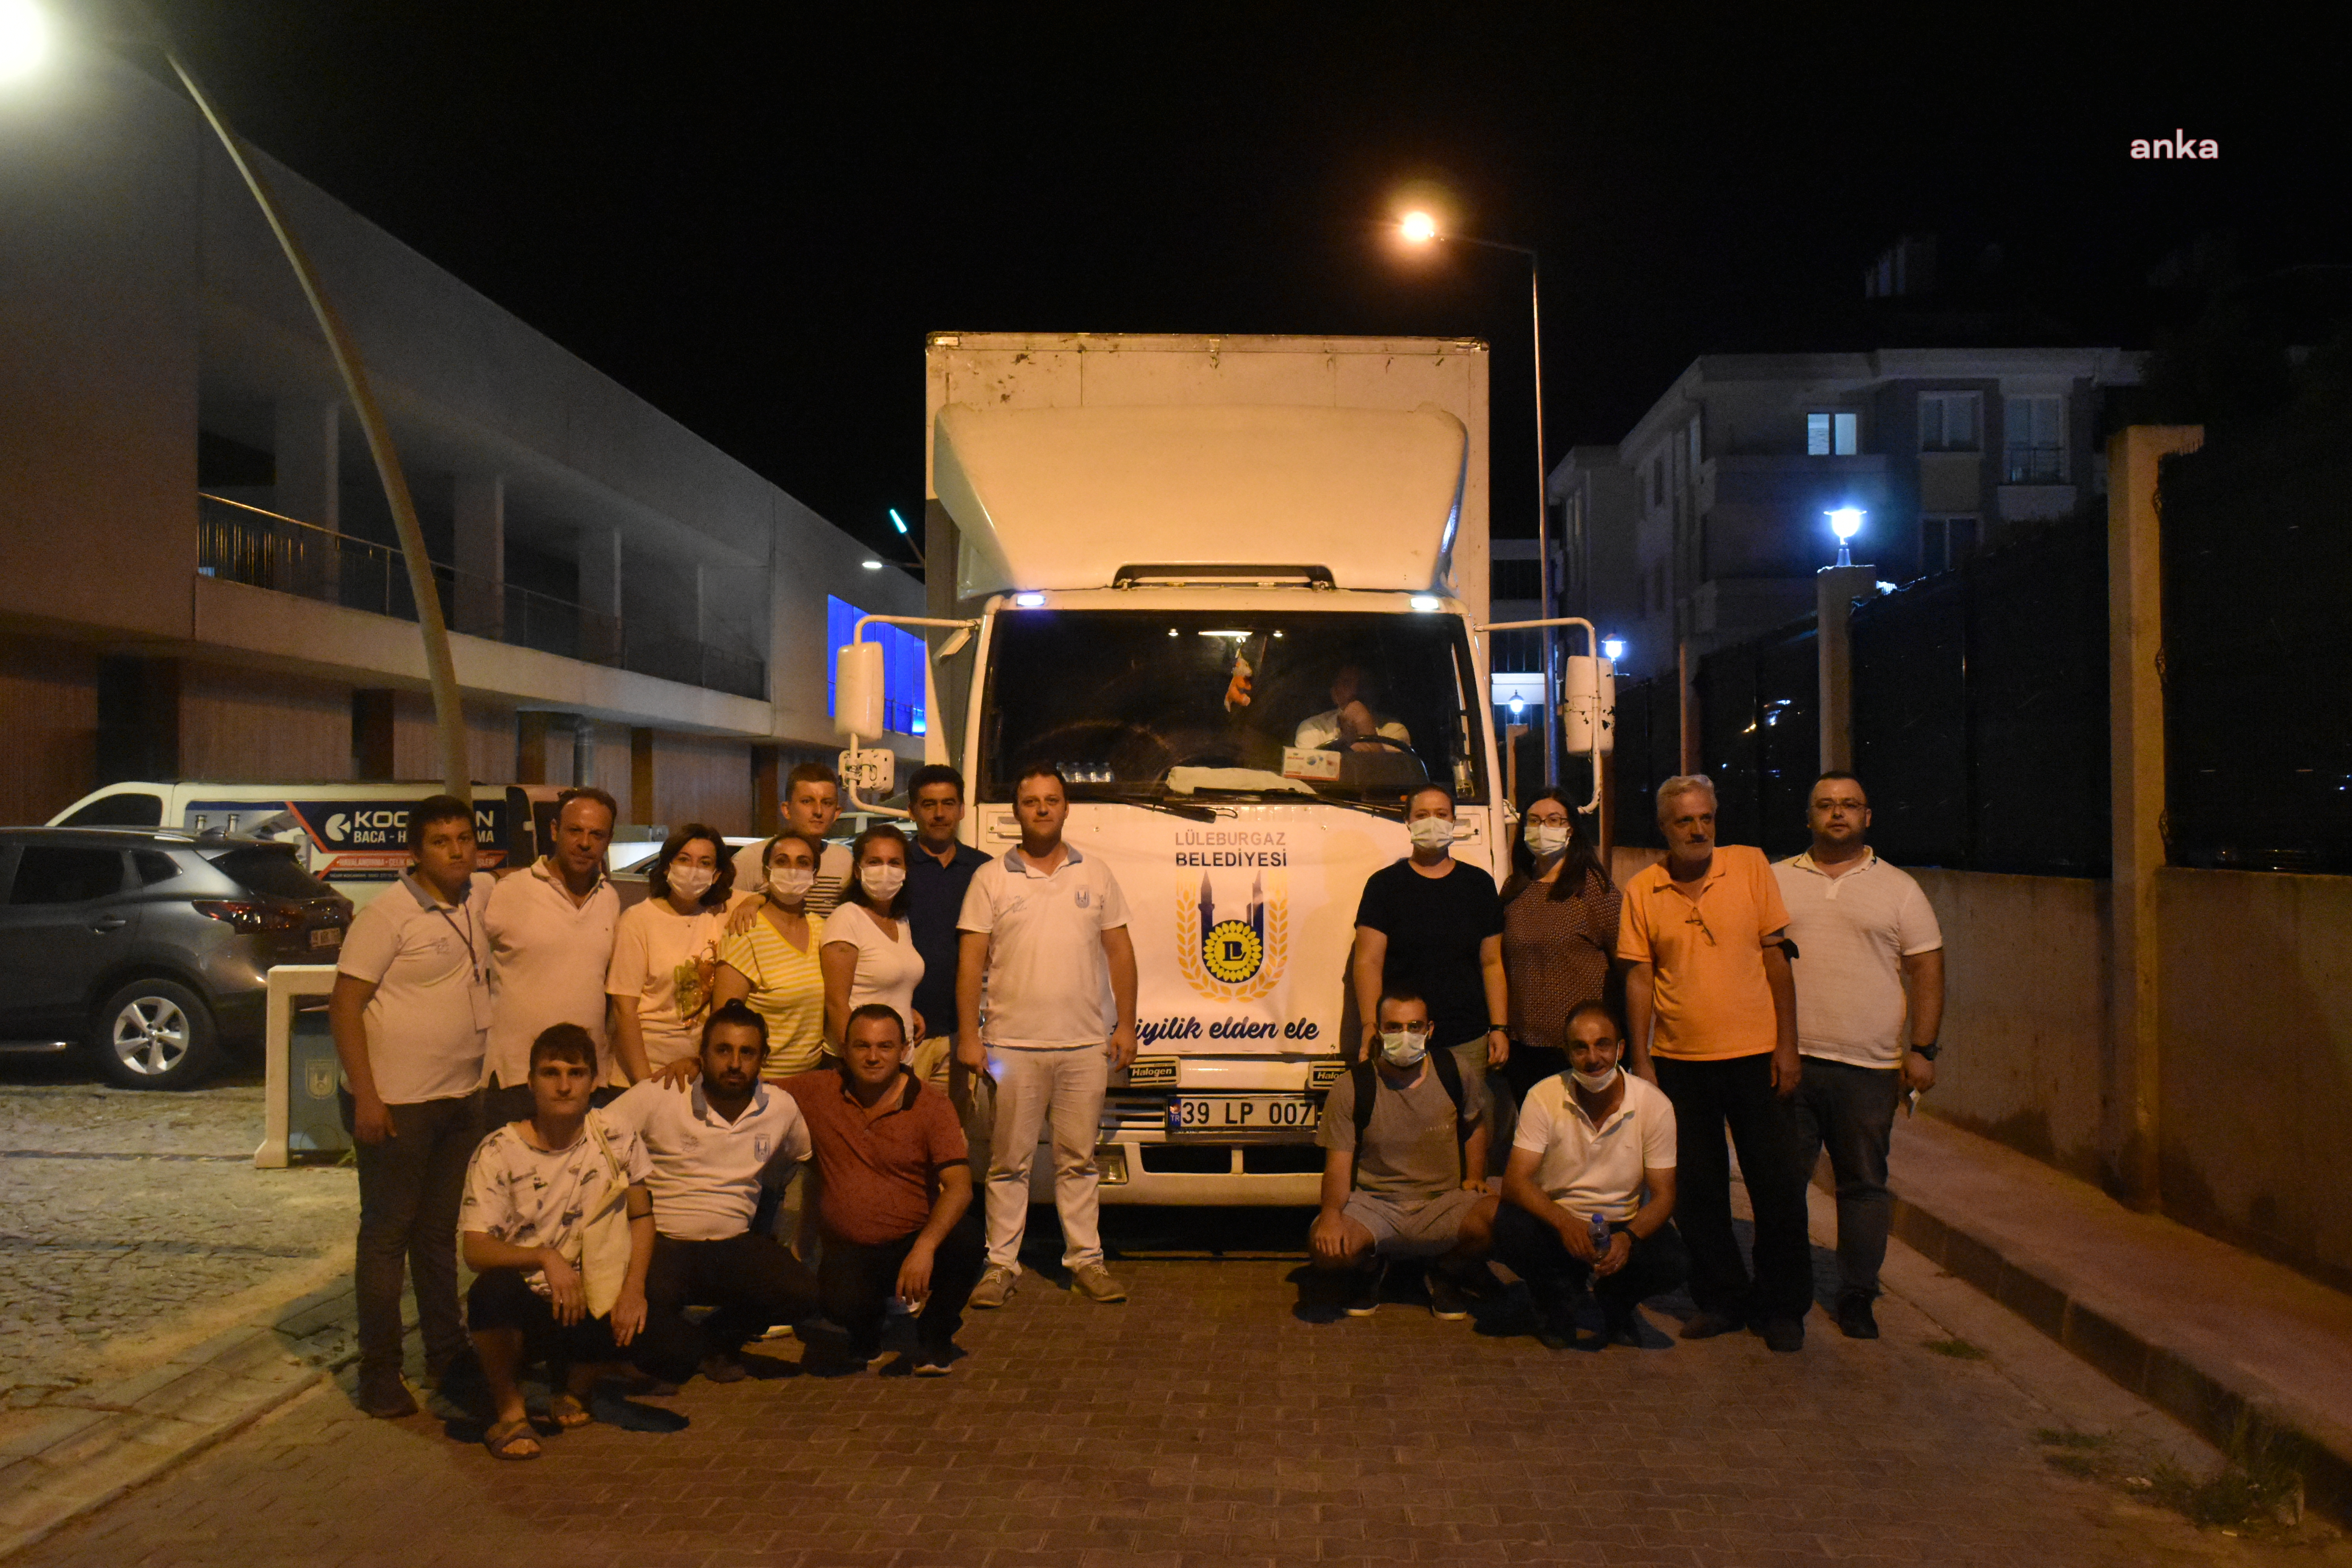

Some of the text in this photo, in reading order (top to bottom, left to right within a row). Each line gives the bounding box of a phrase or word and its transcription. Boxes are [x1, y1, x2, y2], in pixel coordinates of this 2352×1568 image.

[354, 831, 386, 843] BACA
[1175, 829, 1286, 845] LÜLEBURGAZ
[1176, 848, 1287, 867] BELEDİYESİ
[1109, 1016, 1319, 1046] iyilik elden ele
[1132, 1067, 1172, 1078] Halogen
[1182, 1102, 1312, 1125] 39 LP 007
